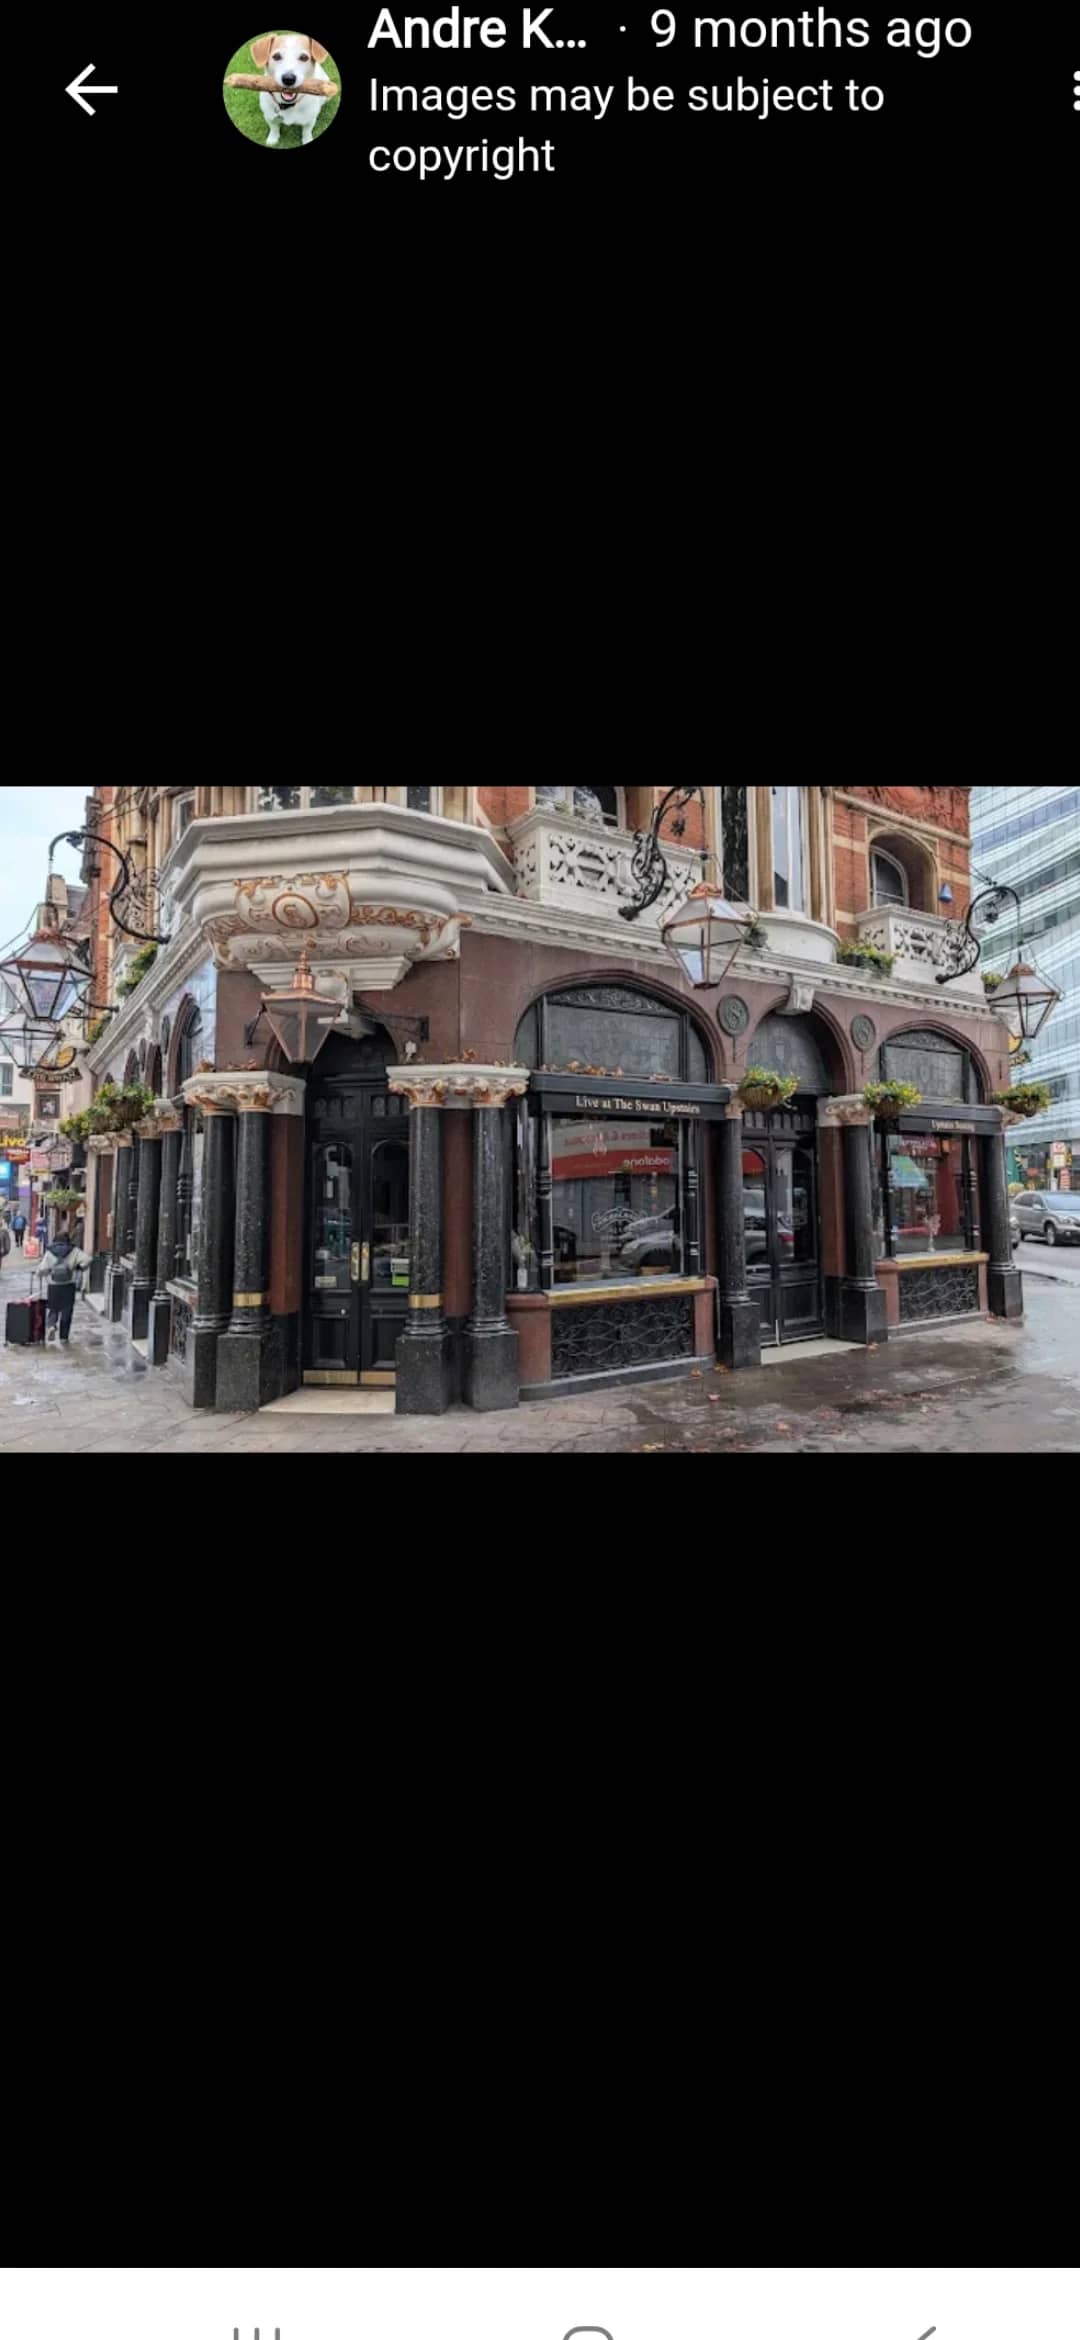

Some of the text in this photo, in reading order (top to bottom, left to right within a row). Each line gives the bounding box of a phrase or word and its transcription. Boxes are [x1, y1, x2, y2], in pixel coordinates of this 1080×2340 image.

[575, 1095, 700, 1116] Live at The Swan Upstairs
